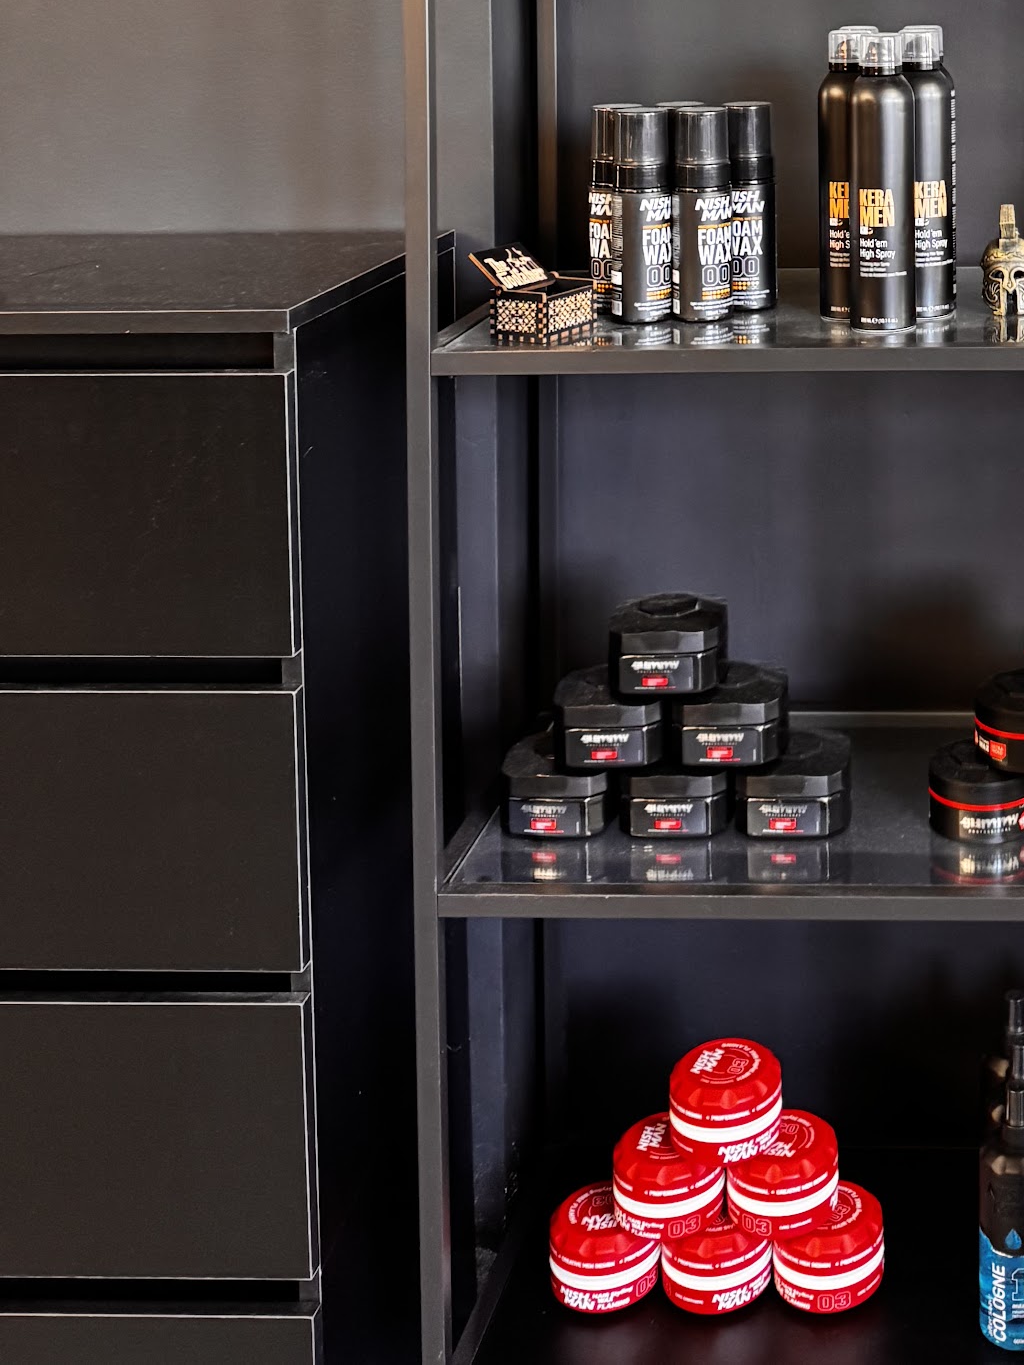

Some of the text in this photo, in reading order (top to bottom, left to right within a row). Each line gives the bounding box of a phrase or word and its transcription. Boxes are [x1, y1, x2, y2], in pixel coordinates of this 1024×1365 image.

[860, 189, 894, 206] KERA
[914, 181, 947, 198] KERA
[701, 206, 732, 221] MAN
[860, 207, 895, 227] MEN
[914, 198, 948, 218] MEN
[732, 220, 763, 236] OAM
[915, 230, 929, 238] Hold
[860, 239, 874, 248] Hold
[915, 239, 948, 250] High Spray
[698, 243, 732, 265] WAX
[860, 249, 896, 260] High Spray
[702, 263, 730, 286] 00
[668, 1215, 701, 1238] 03
[742, 1213, 772, 1236] 03
[818, 1291, 851, 1312] 03
[992, 1262, 1006, 1342] COLOGNE
